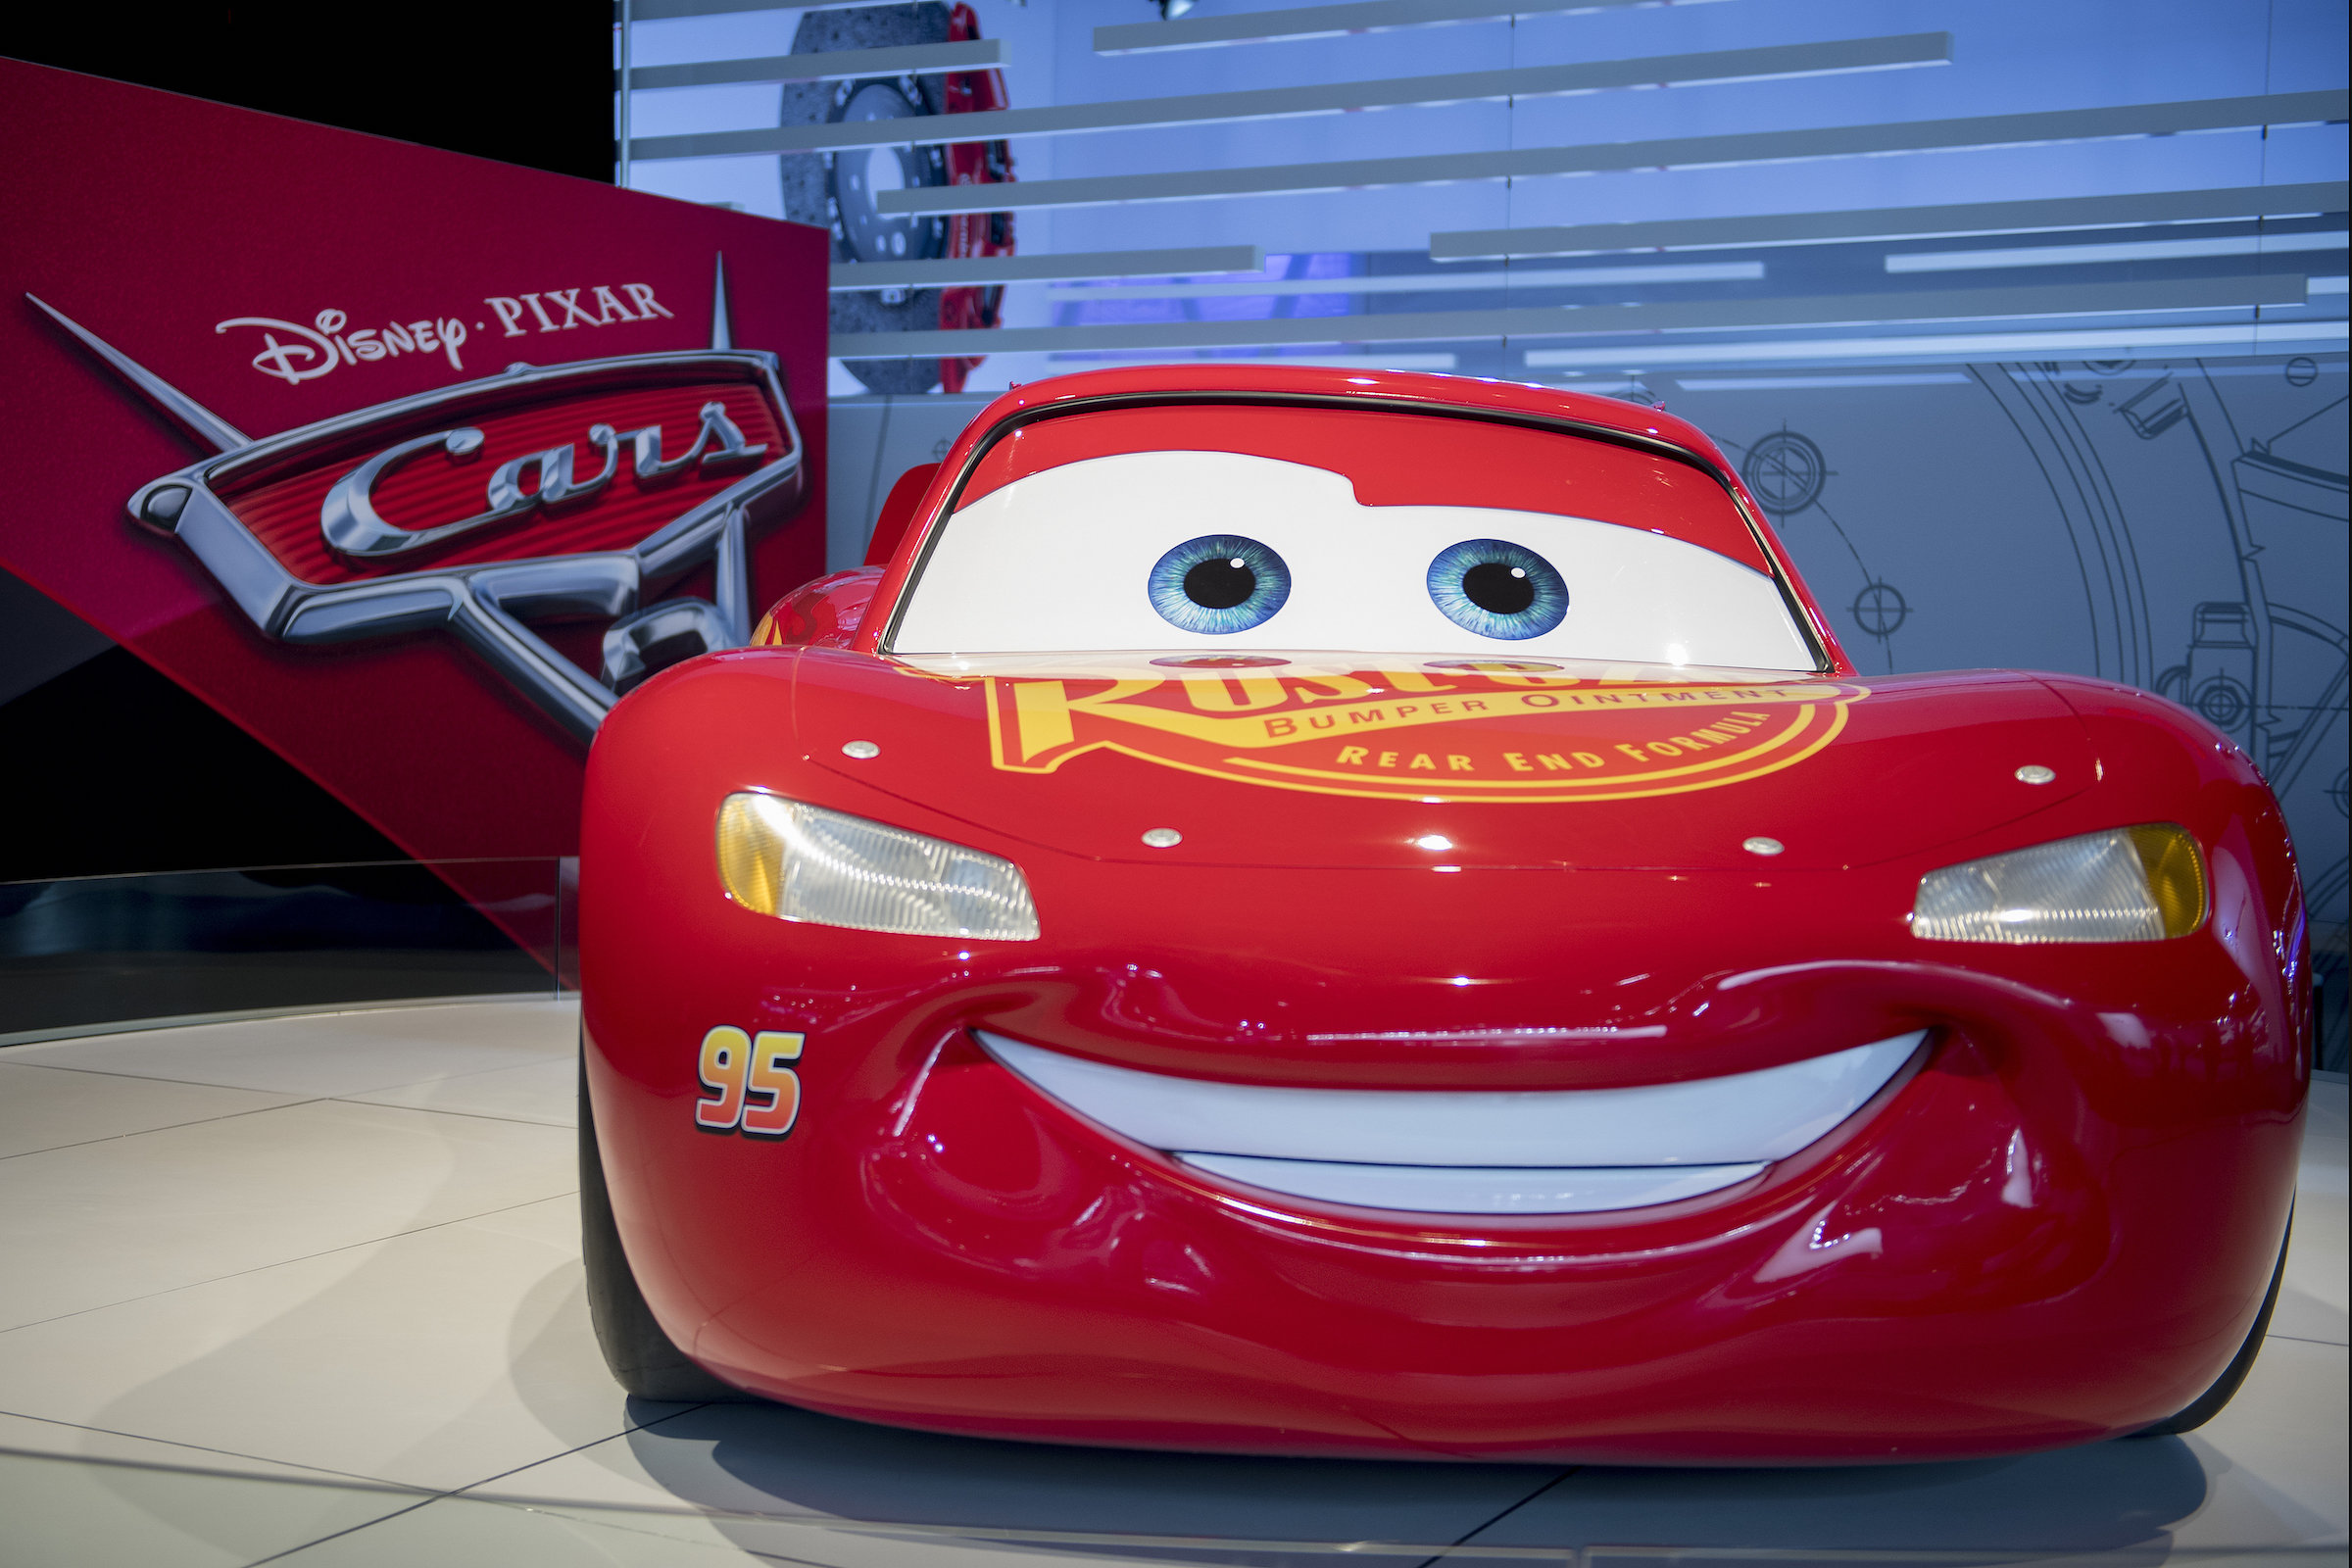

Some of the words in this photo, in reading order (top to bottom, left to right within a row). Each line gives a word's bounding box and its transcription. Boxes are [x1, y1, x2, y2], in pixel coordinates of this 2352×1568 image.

[484, 282, 674, 337] PIXAR
[320, 401, 768, 557] Cars
[1263, 699, 1490, 739] BUMPER
[1521, 689, 1789, 708] OINTMENT
[1336, 745, 1476, 771] REAR
[1502, 752, 1605, 772] END
[1614, 710, 1772, 763] FORMULA
[696, 1024, 806, 1141] 95
